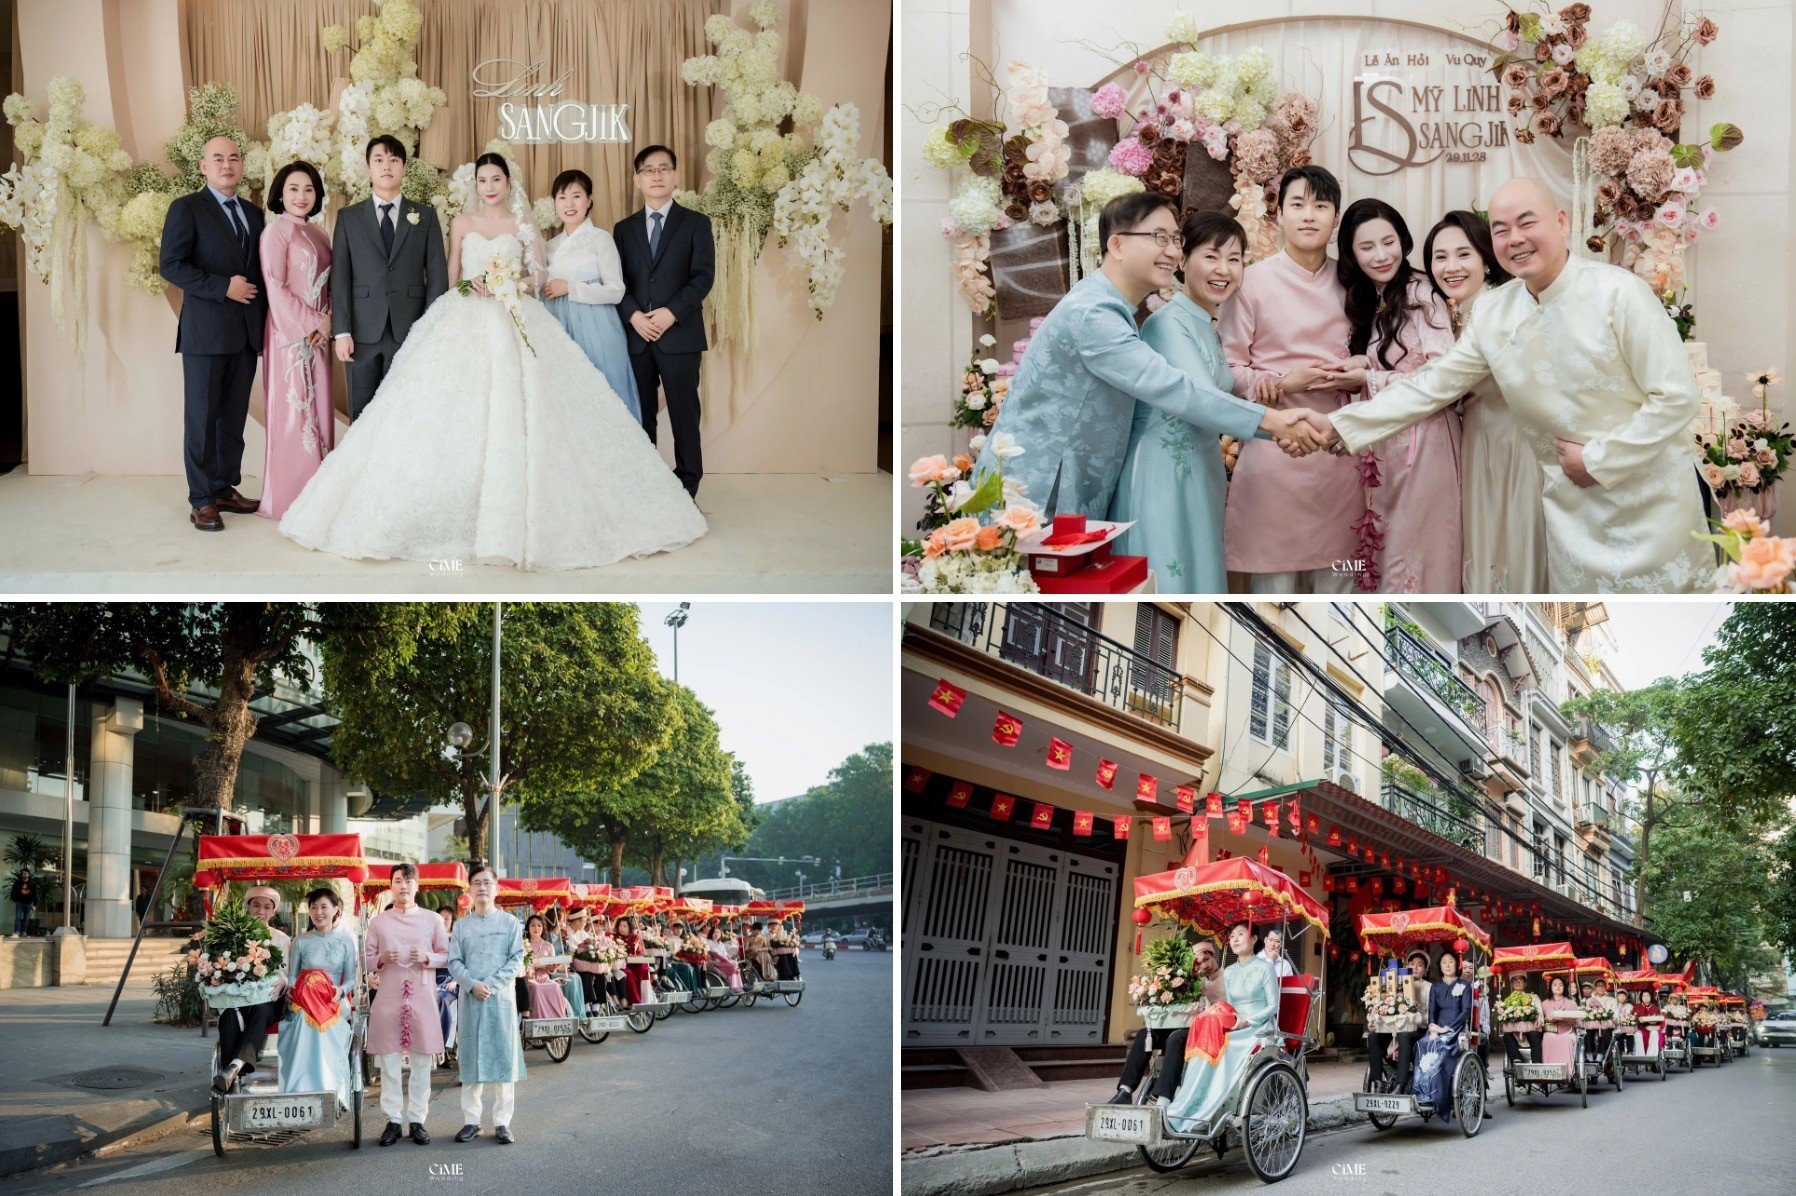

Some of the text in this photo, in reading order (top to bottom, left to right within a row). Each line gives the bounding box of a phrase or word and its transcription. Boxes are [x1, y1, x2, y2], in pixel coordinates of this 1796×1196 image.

[501, 102, 630, 141] SANGJIK
[252, 1106, 313, 1119] 29XL-0061
[1100, 1117, 1143, 1132] 29XL-0061
